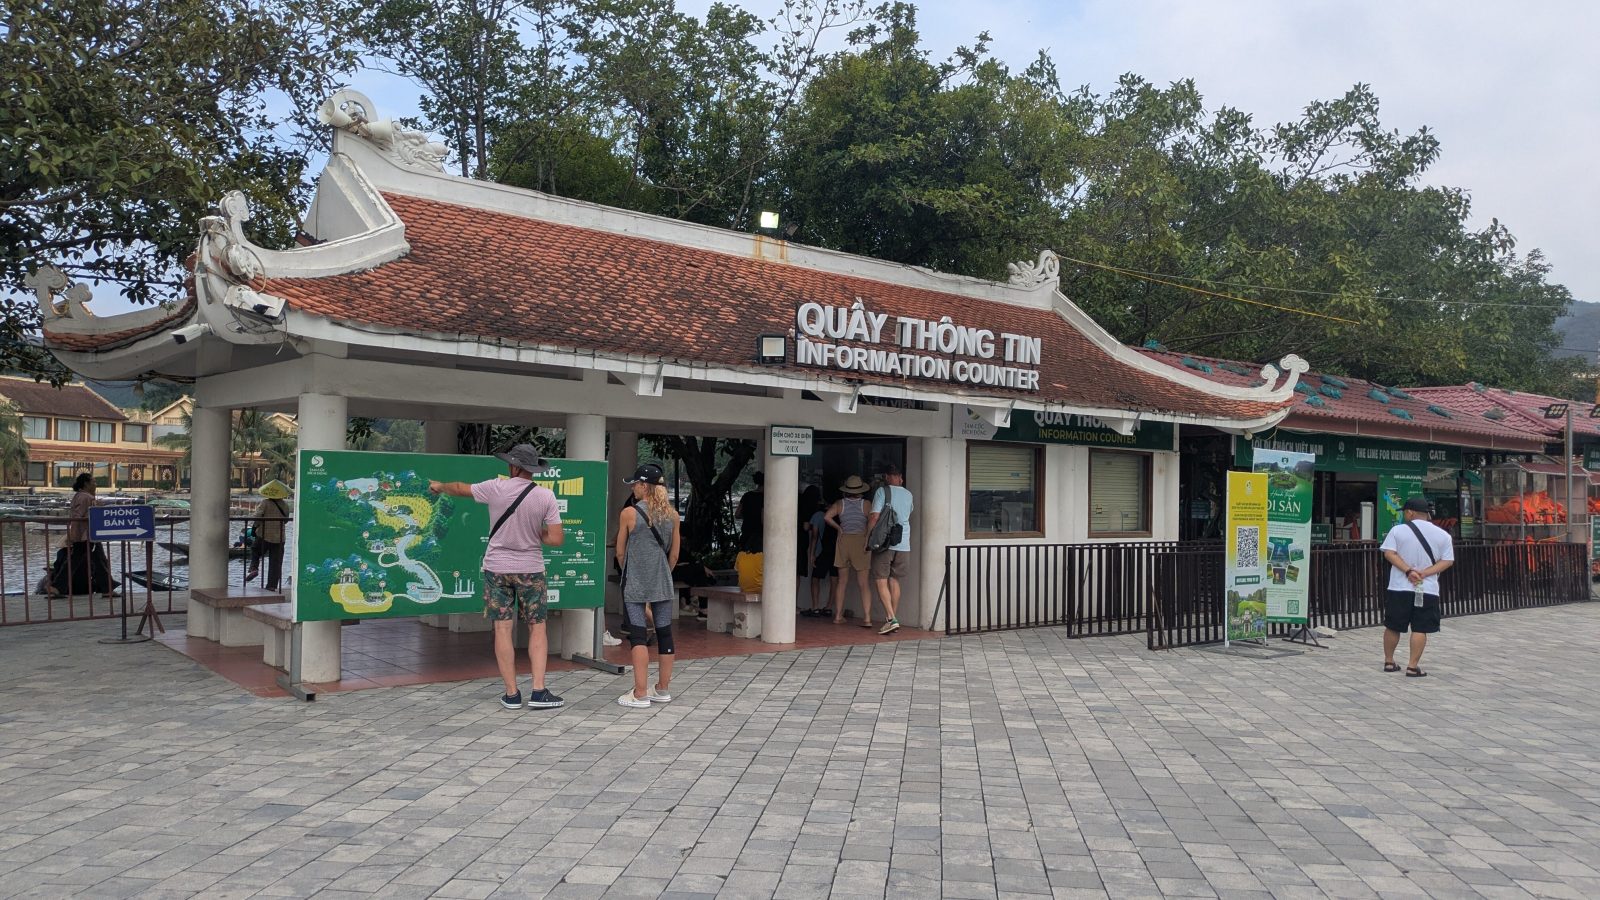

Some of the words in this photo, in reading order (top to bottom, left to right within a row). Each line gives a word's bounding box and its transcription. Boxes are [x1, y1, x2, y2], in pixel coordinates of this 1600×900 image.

[797, 297, 888, 343] QUẦY
[896, 315, 995, 359] THÔNG
[1001, 332, 1041, 365] TIN
[797, 338, 950, 380] INFORMATION
[952, 360, 1040, 390] COUNTER
[1038, 428, 1098, 442] INFORMATION
[1099, 433, 1137, 444] COUNTER
[1356, 447, 1367, 459] THE
[1379, 449, 1390, 460] FOR
[1390, 450, 1421, 462] VIETNAMESE
[1429, 449, 1447, 460] GATE
[103, 507, 140, 517] PHÒNG
[103, 517, 125, 527] BÁN
[127, 516, 141, 526] VÉ
